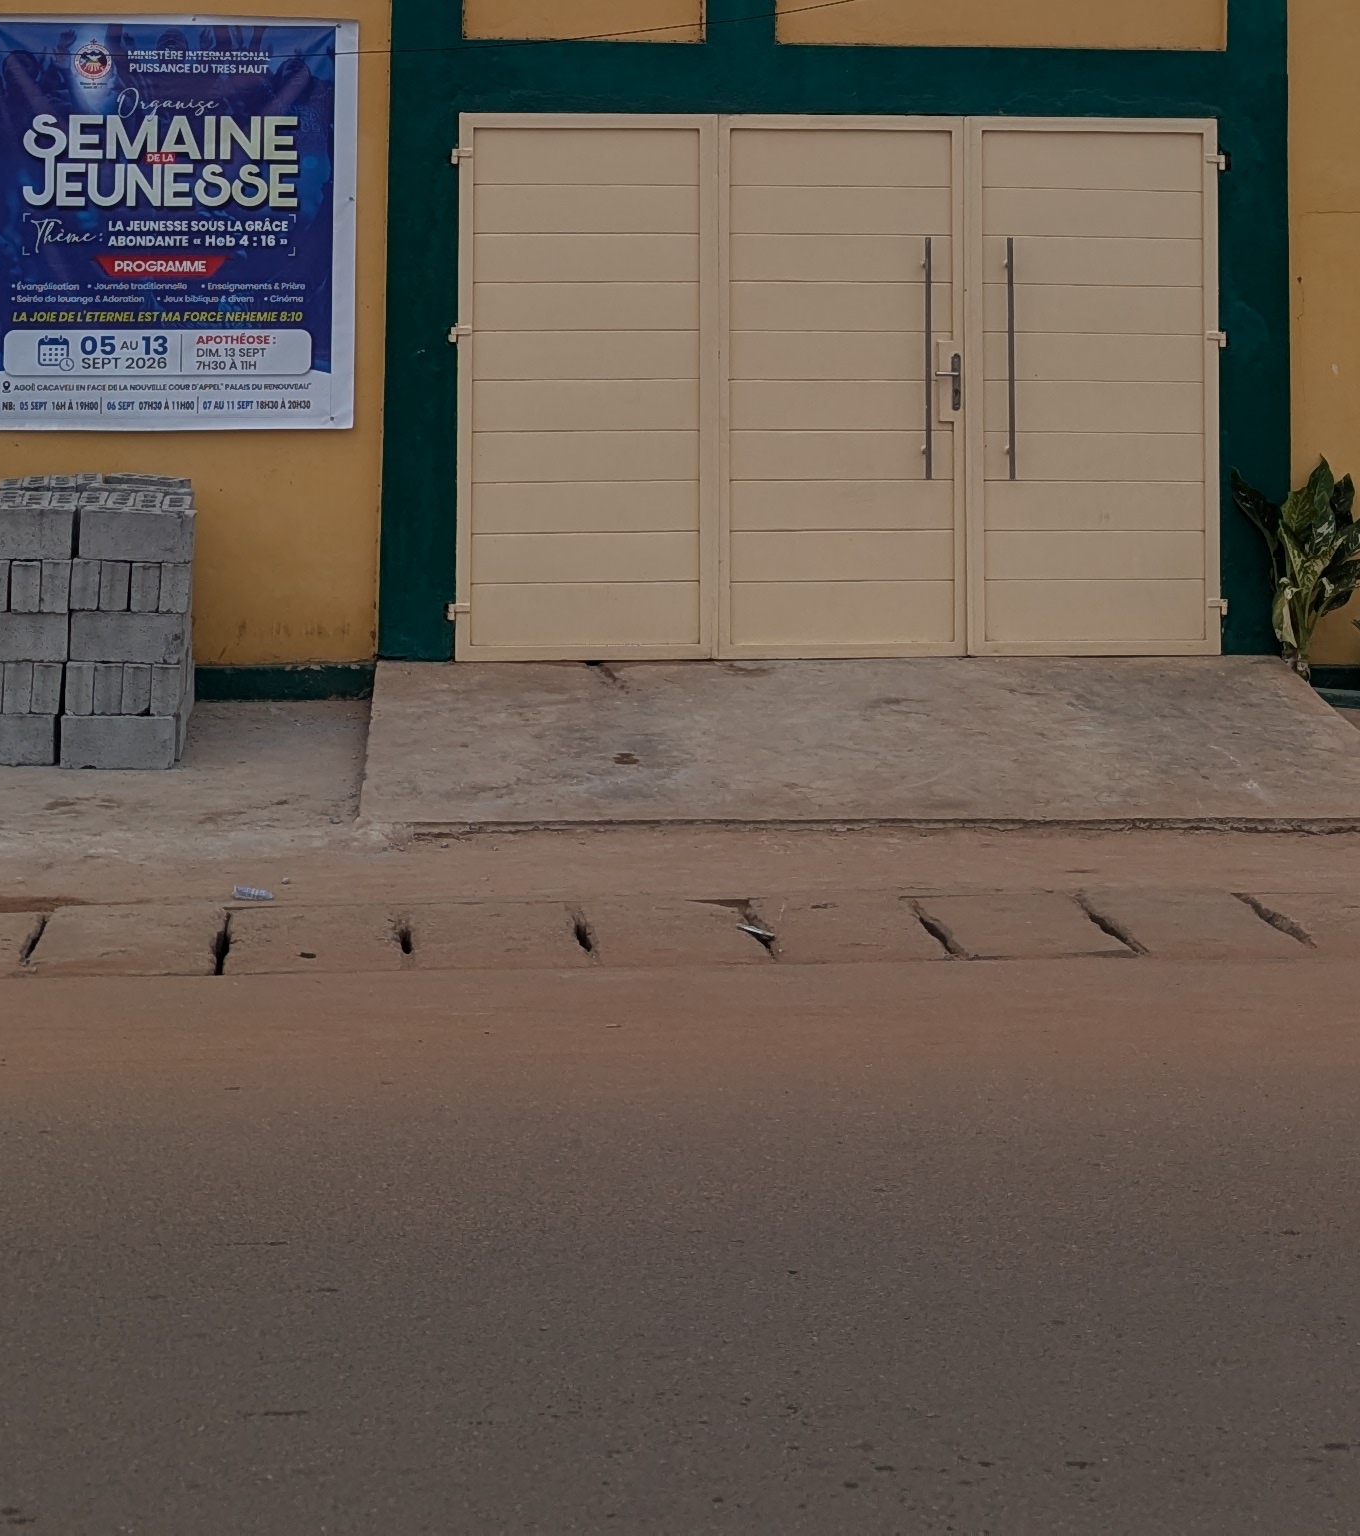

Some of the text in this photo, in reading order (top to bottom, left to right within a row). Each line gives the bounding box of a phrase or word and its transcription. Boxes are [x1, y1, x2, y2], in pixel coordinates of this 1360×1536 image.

[185, 50, 271, 62] INTERNATIONAL
[129, 64, 269, 74] PUISSANCE DU TRES HAUT
[117, 87, 220, 122] Organise
[23, 114, 298, 160] SEMAINE
[147, 154, 174, 163] DE LA
[23, 162, 299, 207] JEUNESSE
[108, 218, 288, 232] LA JEUNESSE SOUS LA GRÂCE
[108, 235, 189, 247] ABONDANTE
[205, 235, 235, 247] Heb
[239, 236, 249, 246] 4
[260, 235, 277, 247] 16
[114, 261, 207, 273] PROGRAMME
[94, 282, 129, 290] Journée
[131, 282, 187, 290] traditionnelle
[208, 282, 273, 292] Enseignements
[281, 282, 306, 290] Prière
[57, 295, 93, 304] louange
[184, 295, 219, 304] biblique
[270, 295, 304, 303] Cinéma
[13, 312, 28, 322] LA
[30, 312, 57, 322] JOIE
[59, 312, 76, 322] DE
[138, 312, 160, 322] EST
[161, 312, 182, 322] MA
[183, 312, 222, 322] FORCE
[225, 312, 278, 322] NEHEMIE
[280, 312, 303, 322] 8:10
[196, 333, 271, 345] APOTHÉOSE
[80, 336, 169, 356] 05 AU 13
[196, 348, 266, 358] DIM. 13 SEPT
[81, 357, 167, 370] SEPT 2026
[196, 359, 257, 370] 7H30 À 11H
[2, 398, 311, 411] NB: 05 SEPT 16H À 19H00 06 SEPT 07H30 À 11H00 07 AU 11 SEPT 18H30 À 20H30
